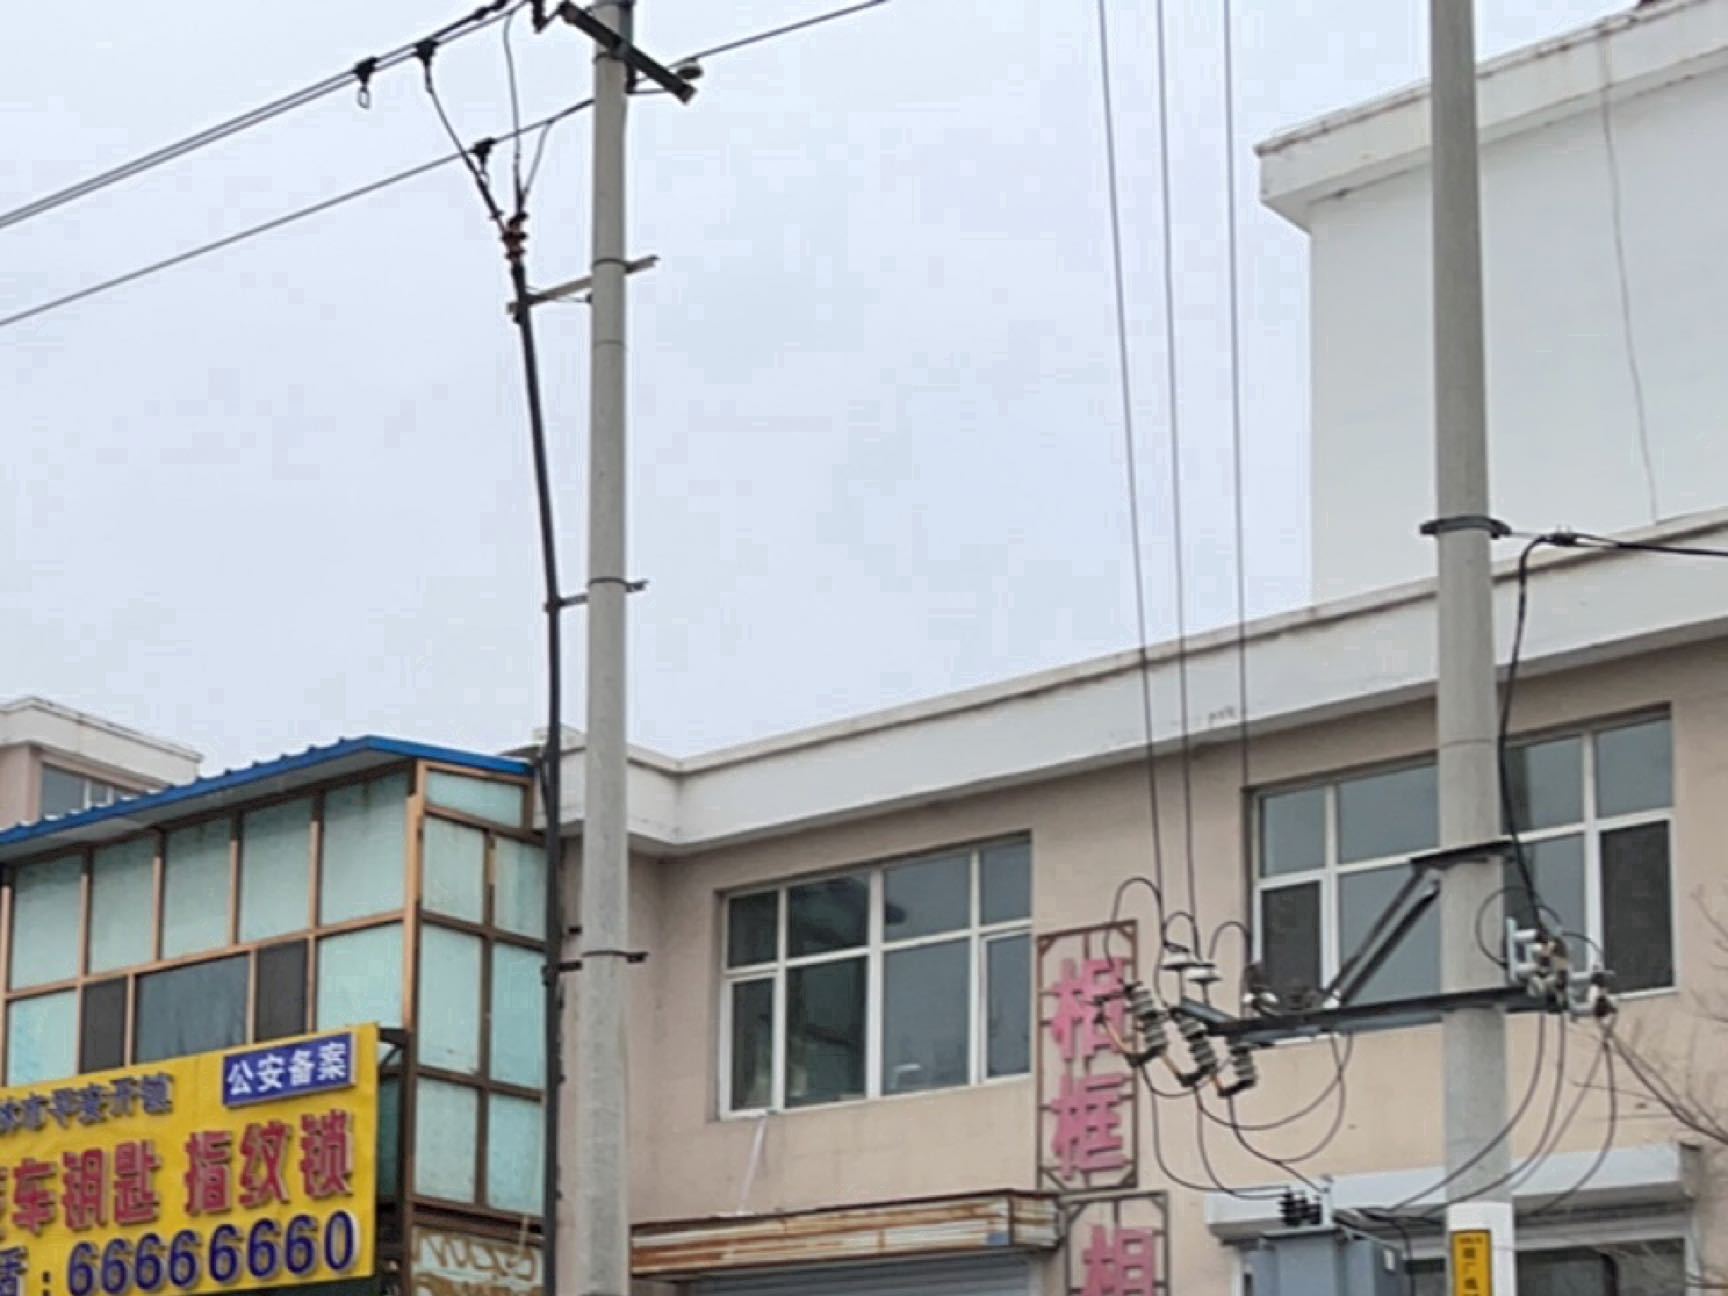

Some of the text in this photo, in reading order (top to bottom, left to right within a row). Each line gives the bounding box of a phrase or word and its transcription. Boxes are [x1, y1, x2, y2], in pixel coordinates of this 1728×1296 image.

[226, 1042, 349, 1096] 公安备案
[183, 1109, 355, 1218] 指纹锁
